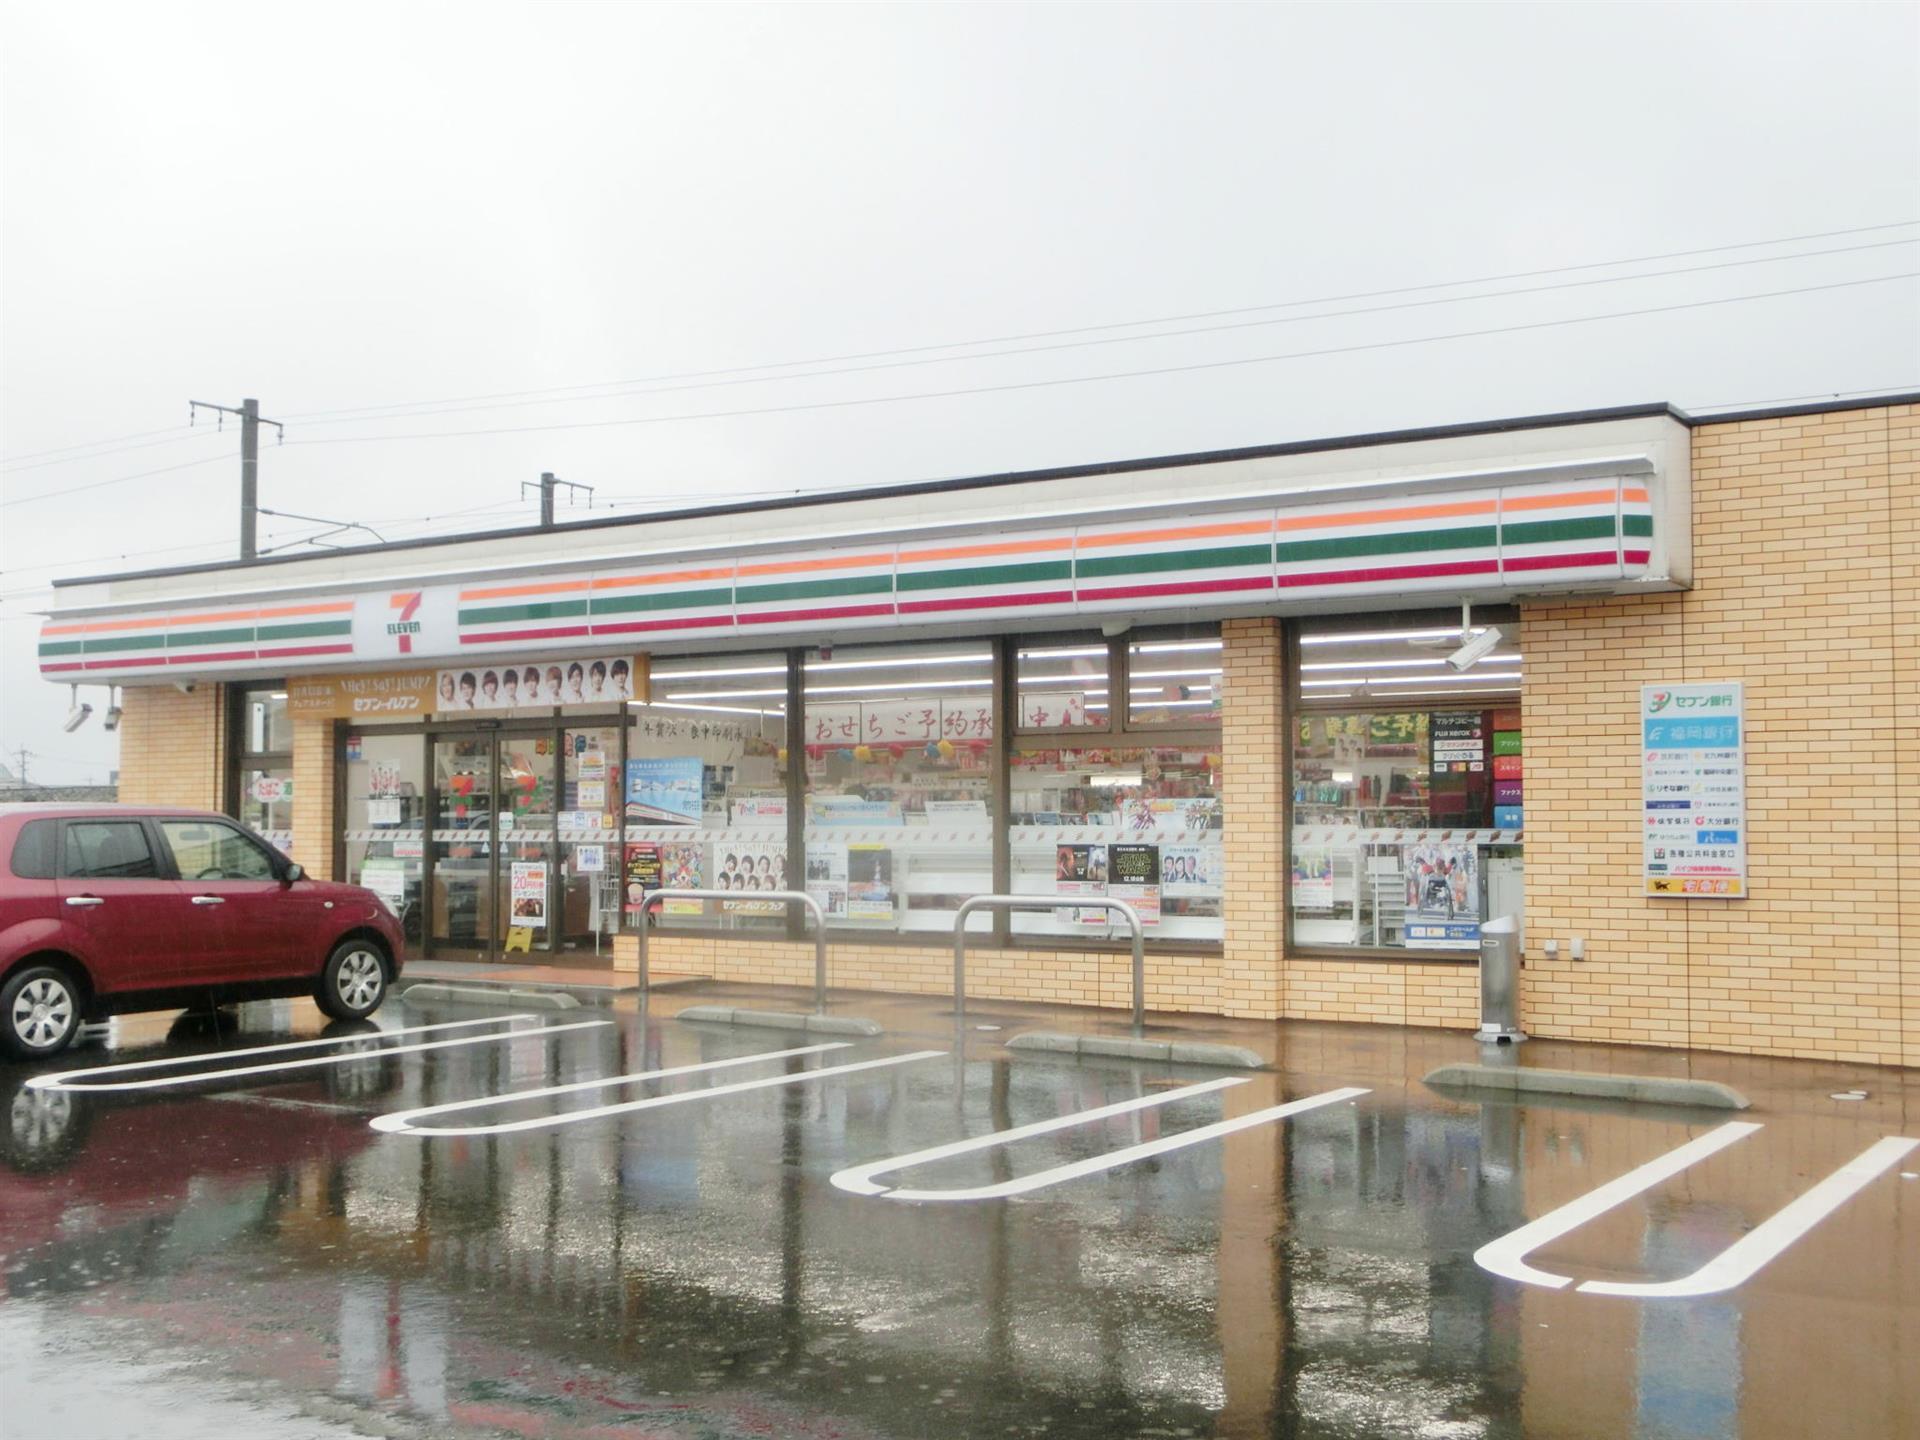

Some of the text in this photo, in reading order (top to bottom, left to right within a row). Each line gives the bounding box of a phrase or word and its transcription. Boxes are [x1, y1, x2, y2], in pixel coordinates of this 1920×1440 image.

[389, 591, 422, 653] 7
[1675, 694, 1733, 708] セブン銀行
[1656, 784, 1690, 792] りそな銀行
[1707, 817, 1738, 825] 大分銀行
[1117, 853, 1150, 864] STAR
[1670, 850, 1735, 858] 各種公共料金窓口
[1117, 864, 1150, 875] WARS
[1681, 880, 1729, 893] 宅急便
